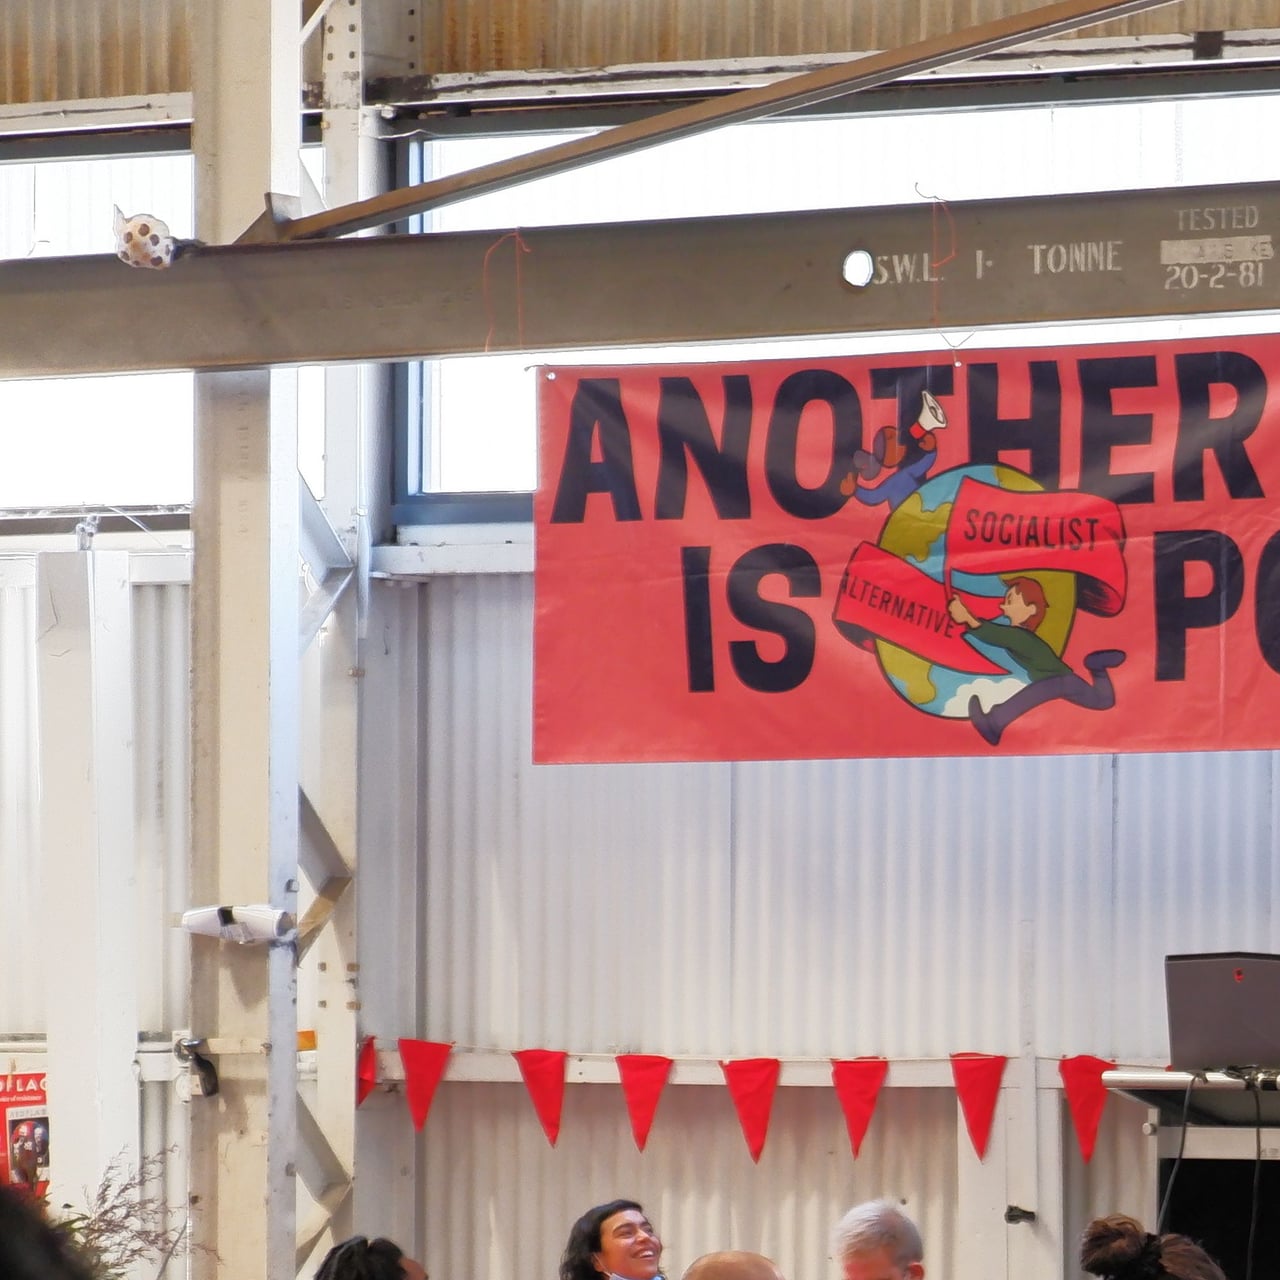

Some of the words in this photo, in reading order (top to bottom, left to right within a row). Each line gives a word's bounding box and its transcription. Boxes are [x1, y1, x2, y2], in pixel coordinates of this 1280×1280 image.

[1175, 206, 1259, 231] TESTED
[1028, 241, 1122, 273] TONNE
[1164, 261, 1263, 290] 20-2-81
[551, 349, 1267, 524] ANOTHER
[963, 508, 1099, 551] SOCIALIST
[682, 543, 822, 693] IS
[841, 570, 955, 638] ALTERNATIVE
